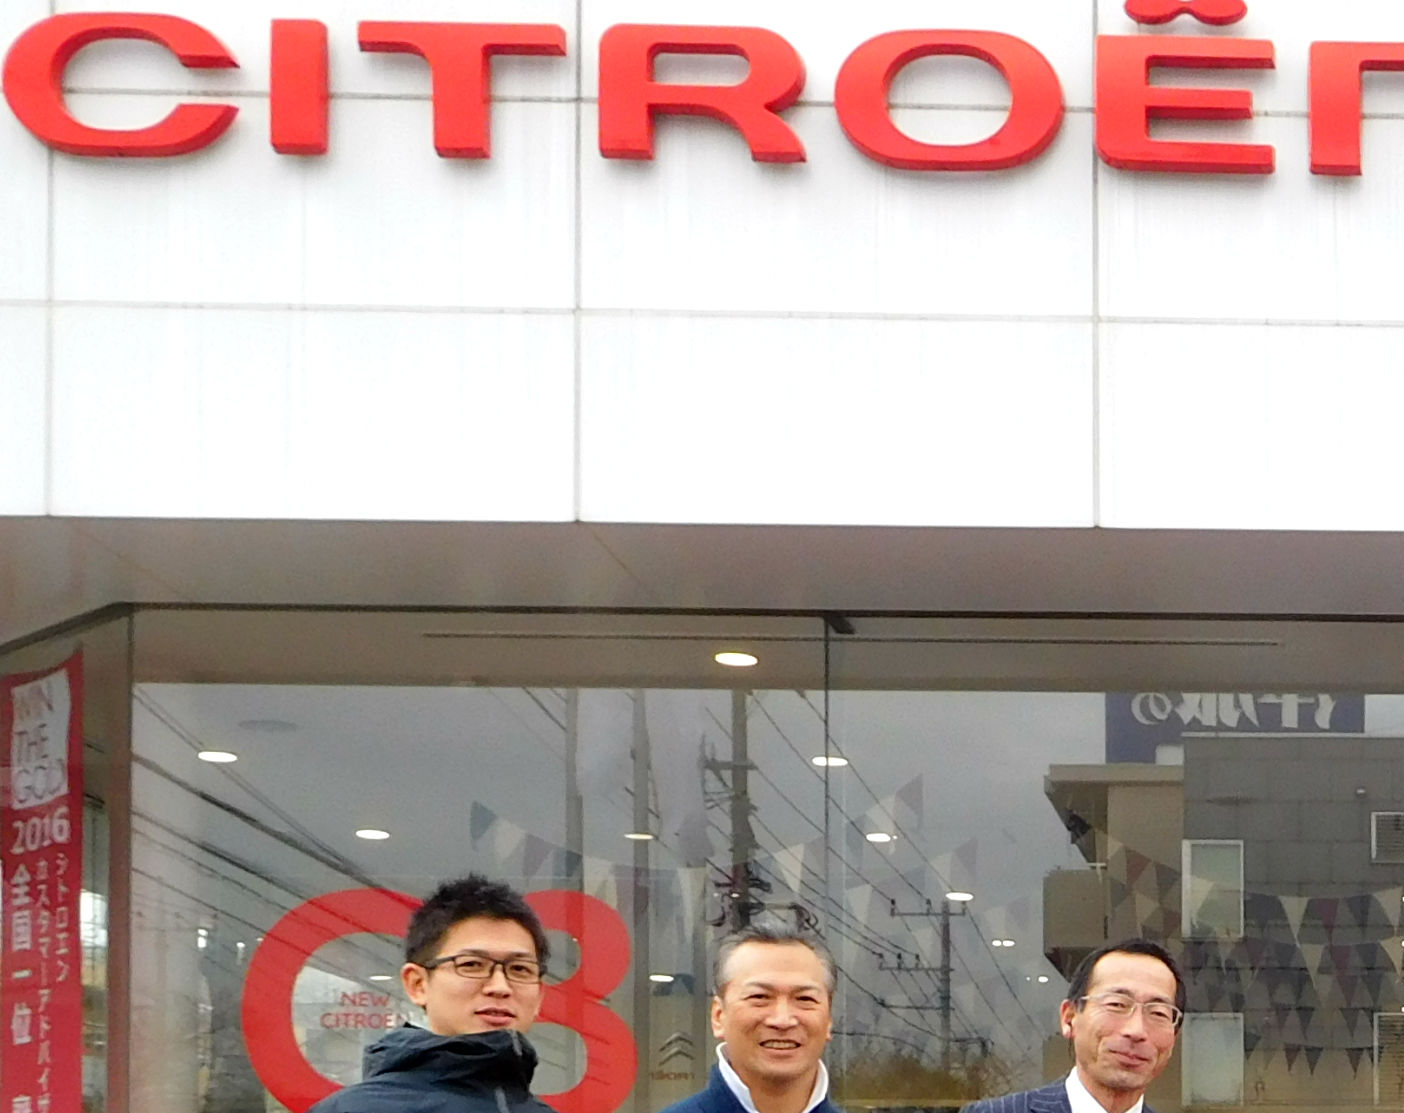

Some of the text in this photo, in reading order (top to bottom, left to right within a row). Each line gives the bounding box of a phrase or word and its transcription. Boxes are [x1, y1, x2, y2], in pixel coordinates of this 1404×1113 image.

[10, 805, 71, 855] 2016
[11, 862, 33, 1045] 全国一位
[55, 852, 70, 982] シトロエン
[340, 991, 391, 1007] NEW
